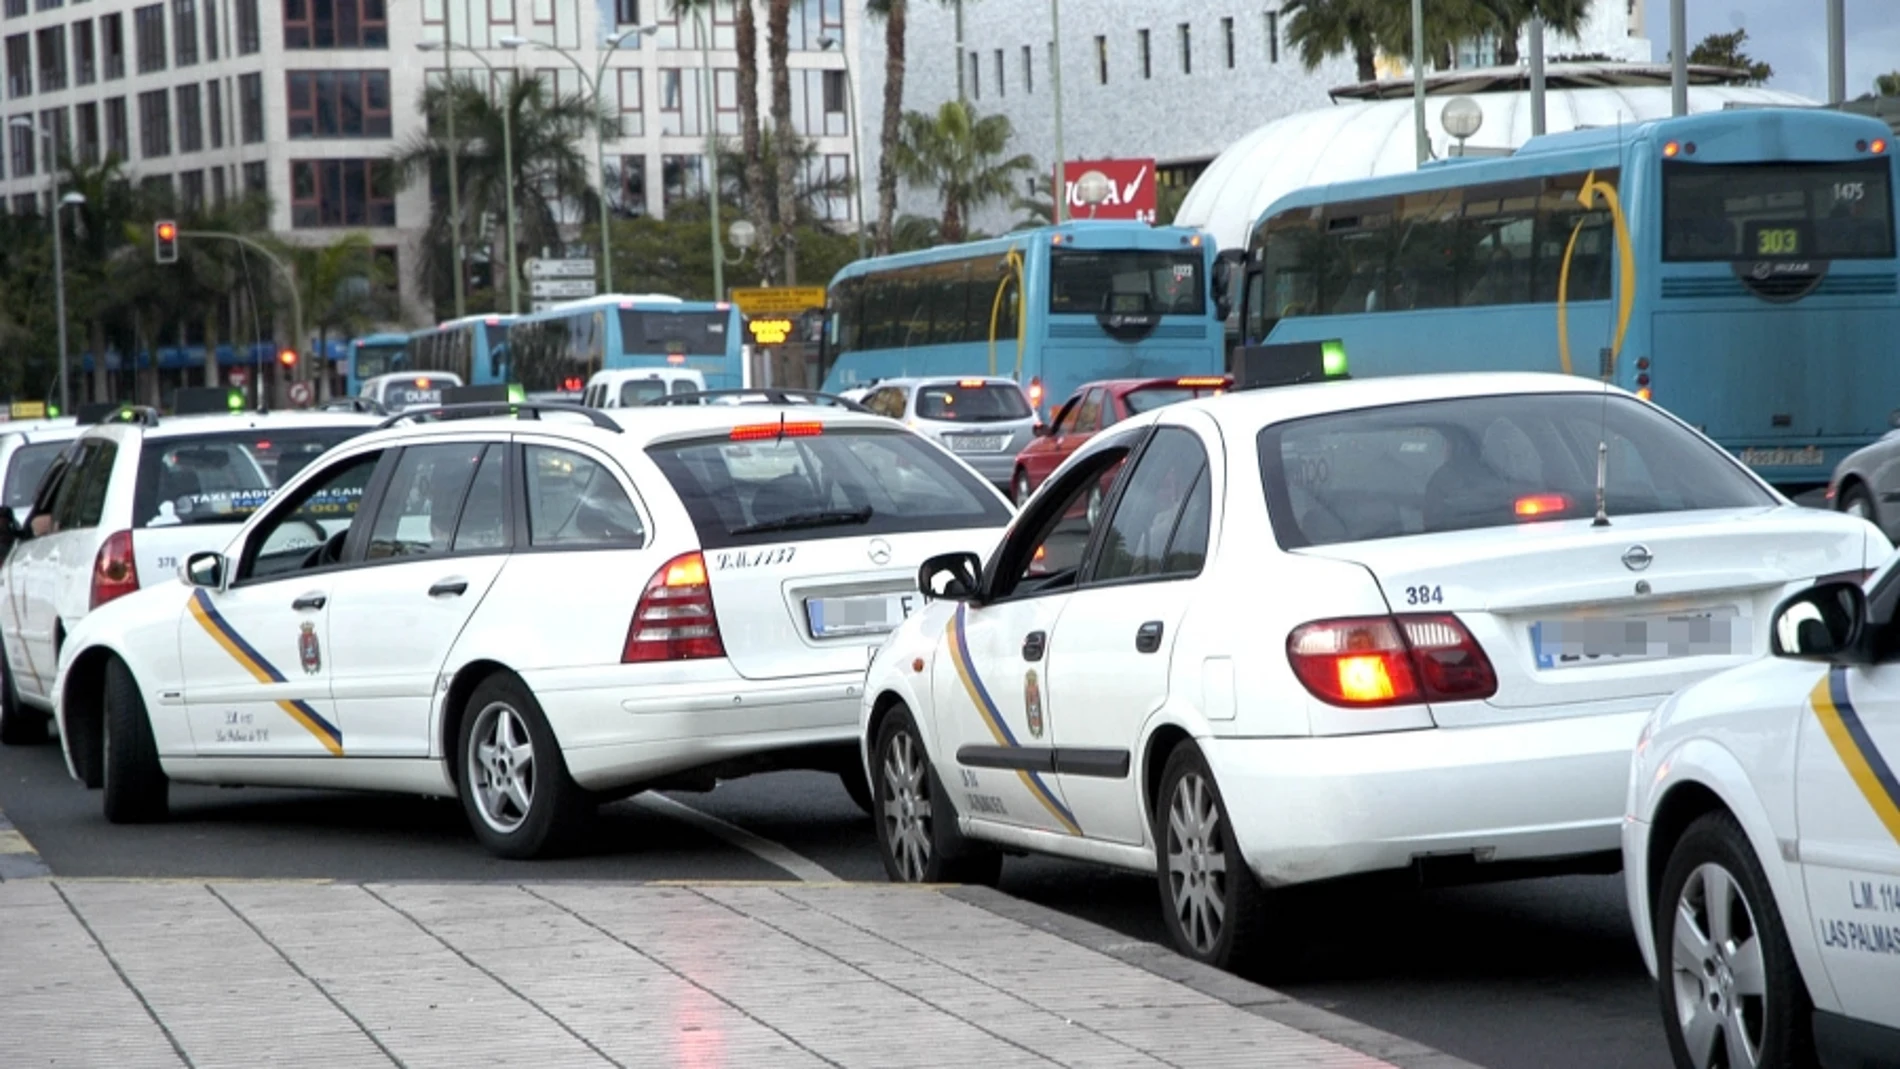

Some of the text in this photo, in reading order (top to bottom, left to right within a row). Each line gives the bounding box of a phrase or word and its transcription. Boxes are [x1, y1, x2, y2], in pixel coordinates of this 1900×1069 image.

[1833, 182, 1864, 200] 1475
[1757, 229, 1797, 255] 303
[191, 493, 227, 504] TAXI
[231, 489, 278, 500] RADIO
[1405, 584, 1444, 605] 384
[1820, 918, 1848, 949] LAS
